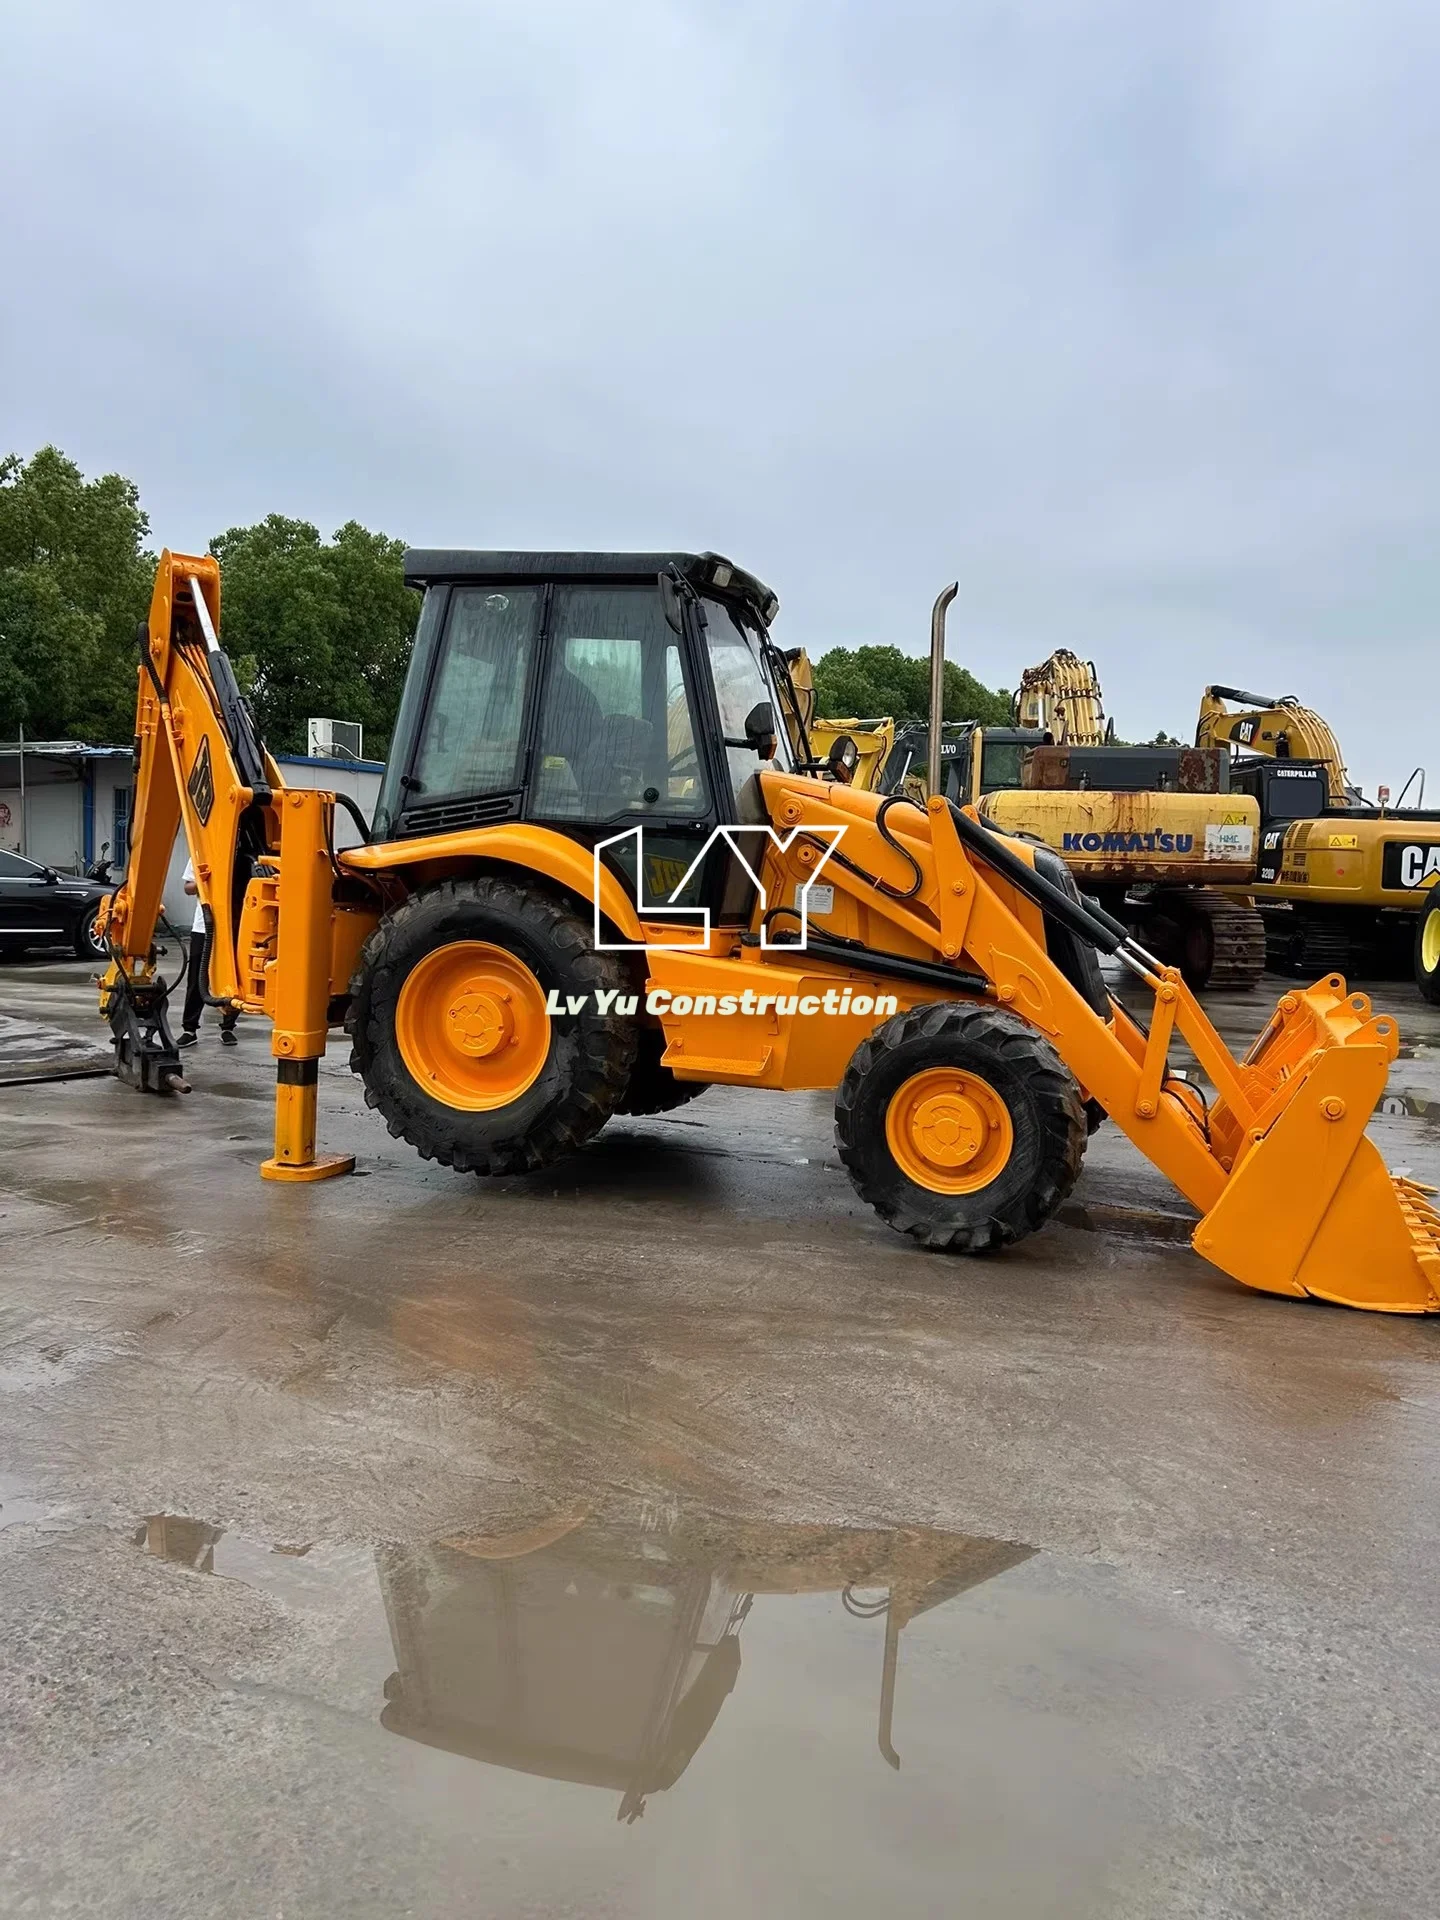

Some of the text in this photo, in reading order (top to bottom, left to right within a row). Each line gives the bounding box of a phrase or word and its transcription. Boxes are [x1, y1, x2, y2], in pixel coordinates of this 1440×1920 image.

[1240, 722, 1253, 742] CAT
[941, 744, 956, 754] LVO
[1277, 769, 1317, 778] CATERPILLAR
[1063, 828, 1193, 853] KOMATSU
[1264, 832, 1281, 850] CAT
